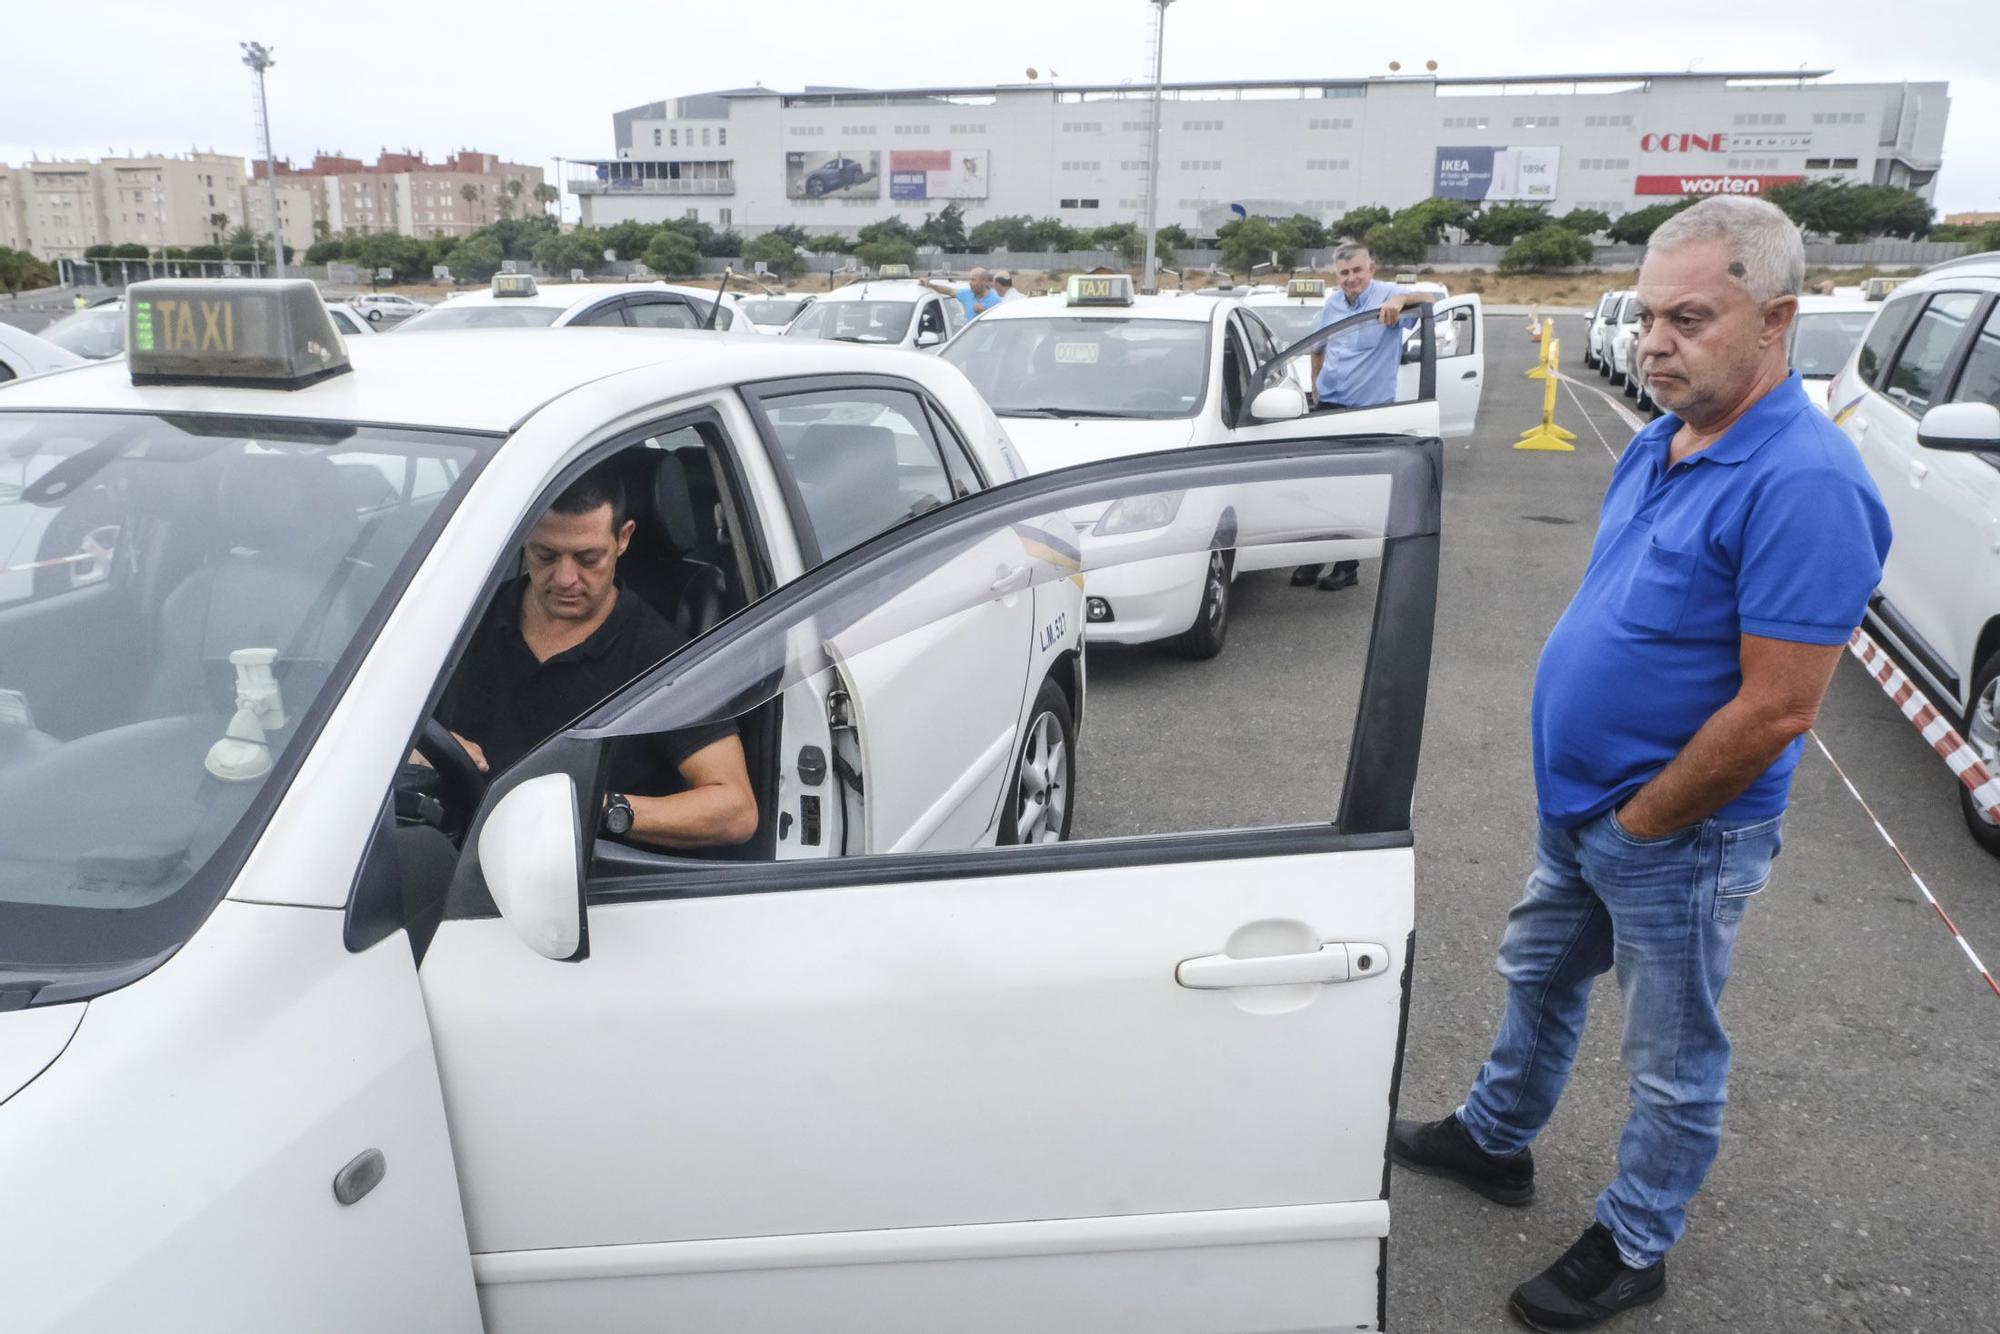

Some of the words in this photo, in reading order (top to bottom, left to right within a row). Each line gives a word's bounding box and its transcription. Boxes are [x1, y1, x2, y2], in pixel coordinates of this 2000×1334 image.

[1641, 133, 1728, 152] OCINE
[1441, 160, 1469, 171] IKEA
[1680, 176, 1759, 192] worten
[1080, 281, 1109, 296] TAXI
[156, 301, 234, 351] TAXI
